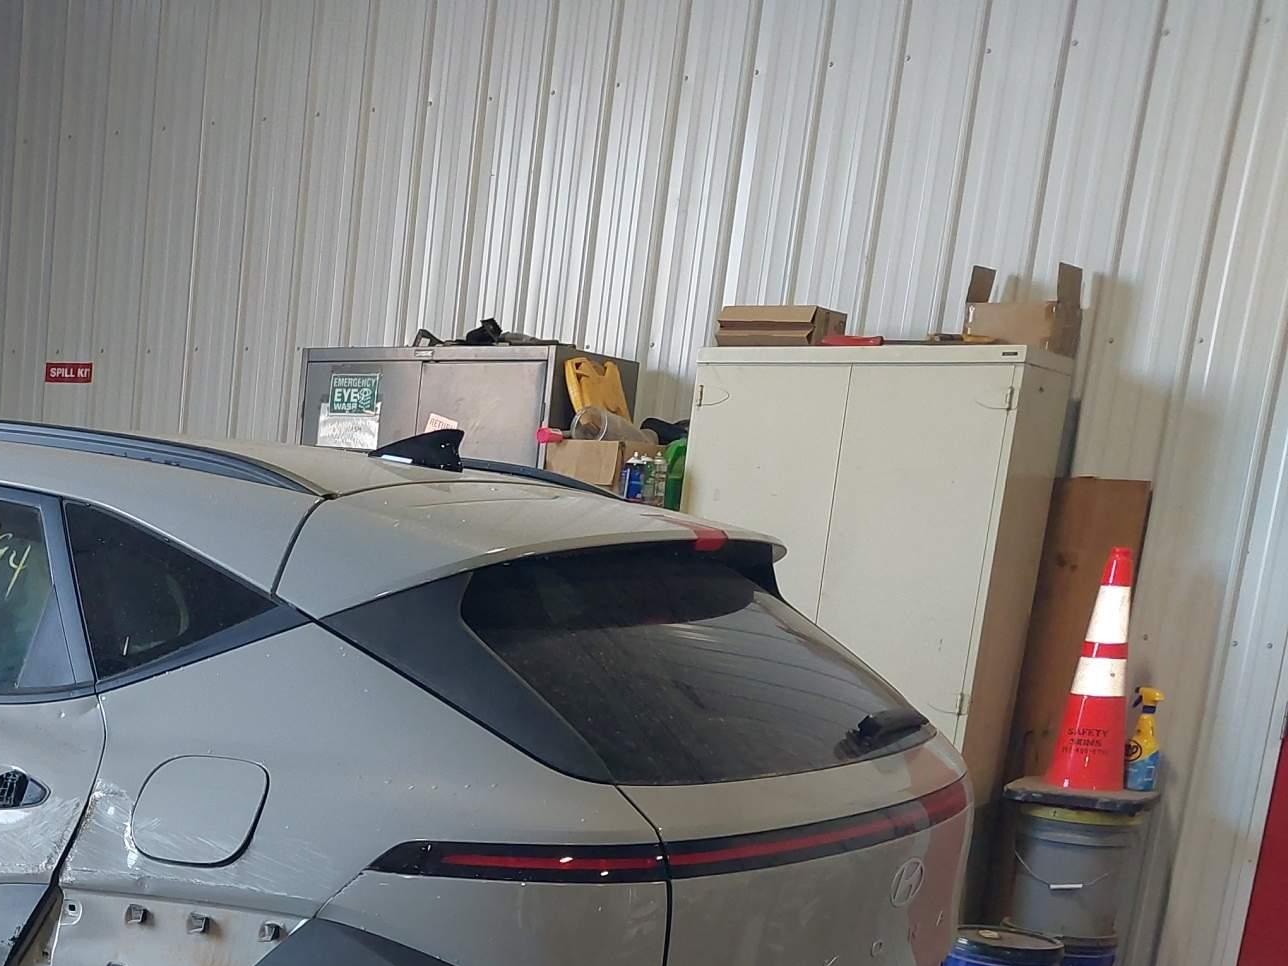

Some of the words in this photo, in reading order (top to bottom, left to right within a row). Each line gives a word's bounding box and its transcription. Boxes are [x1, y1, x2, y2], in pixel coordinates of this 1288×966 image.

[49, 367, 75, 378] SPILL
[77, 367, 91, 378] KIT
[333, 377, 377, 388] EMERGENCY
[334, 388, 359, 402] EYE
[333, 402, 358, 411] WASH
[1067, 727, 1109, 738] SAFETY
